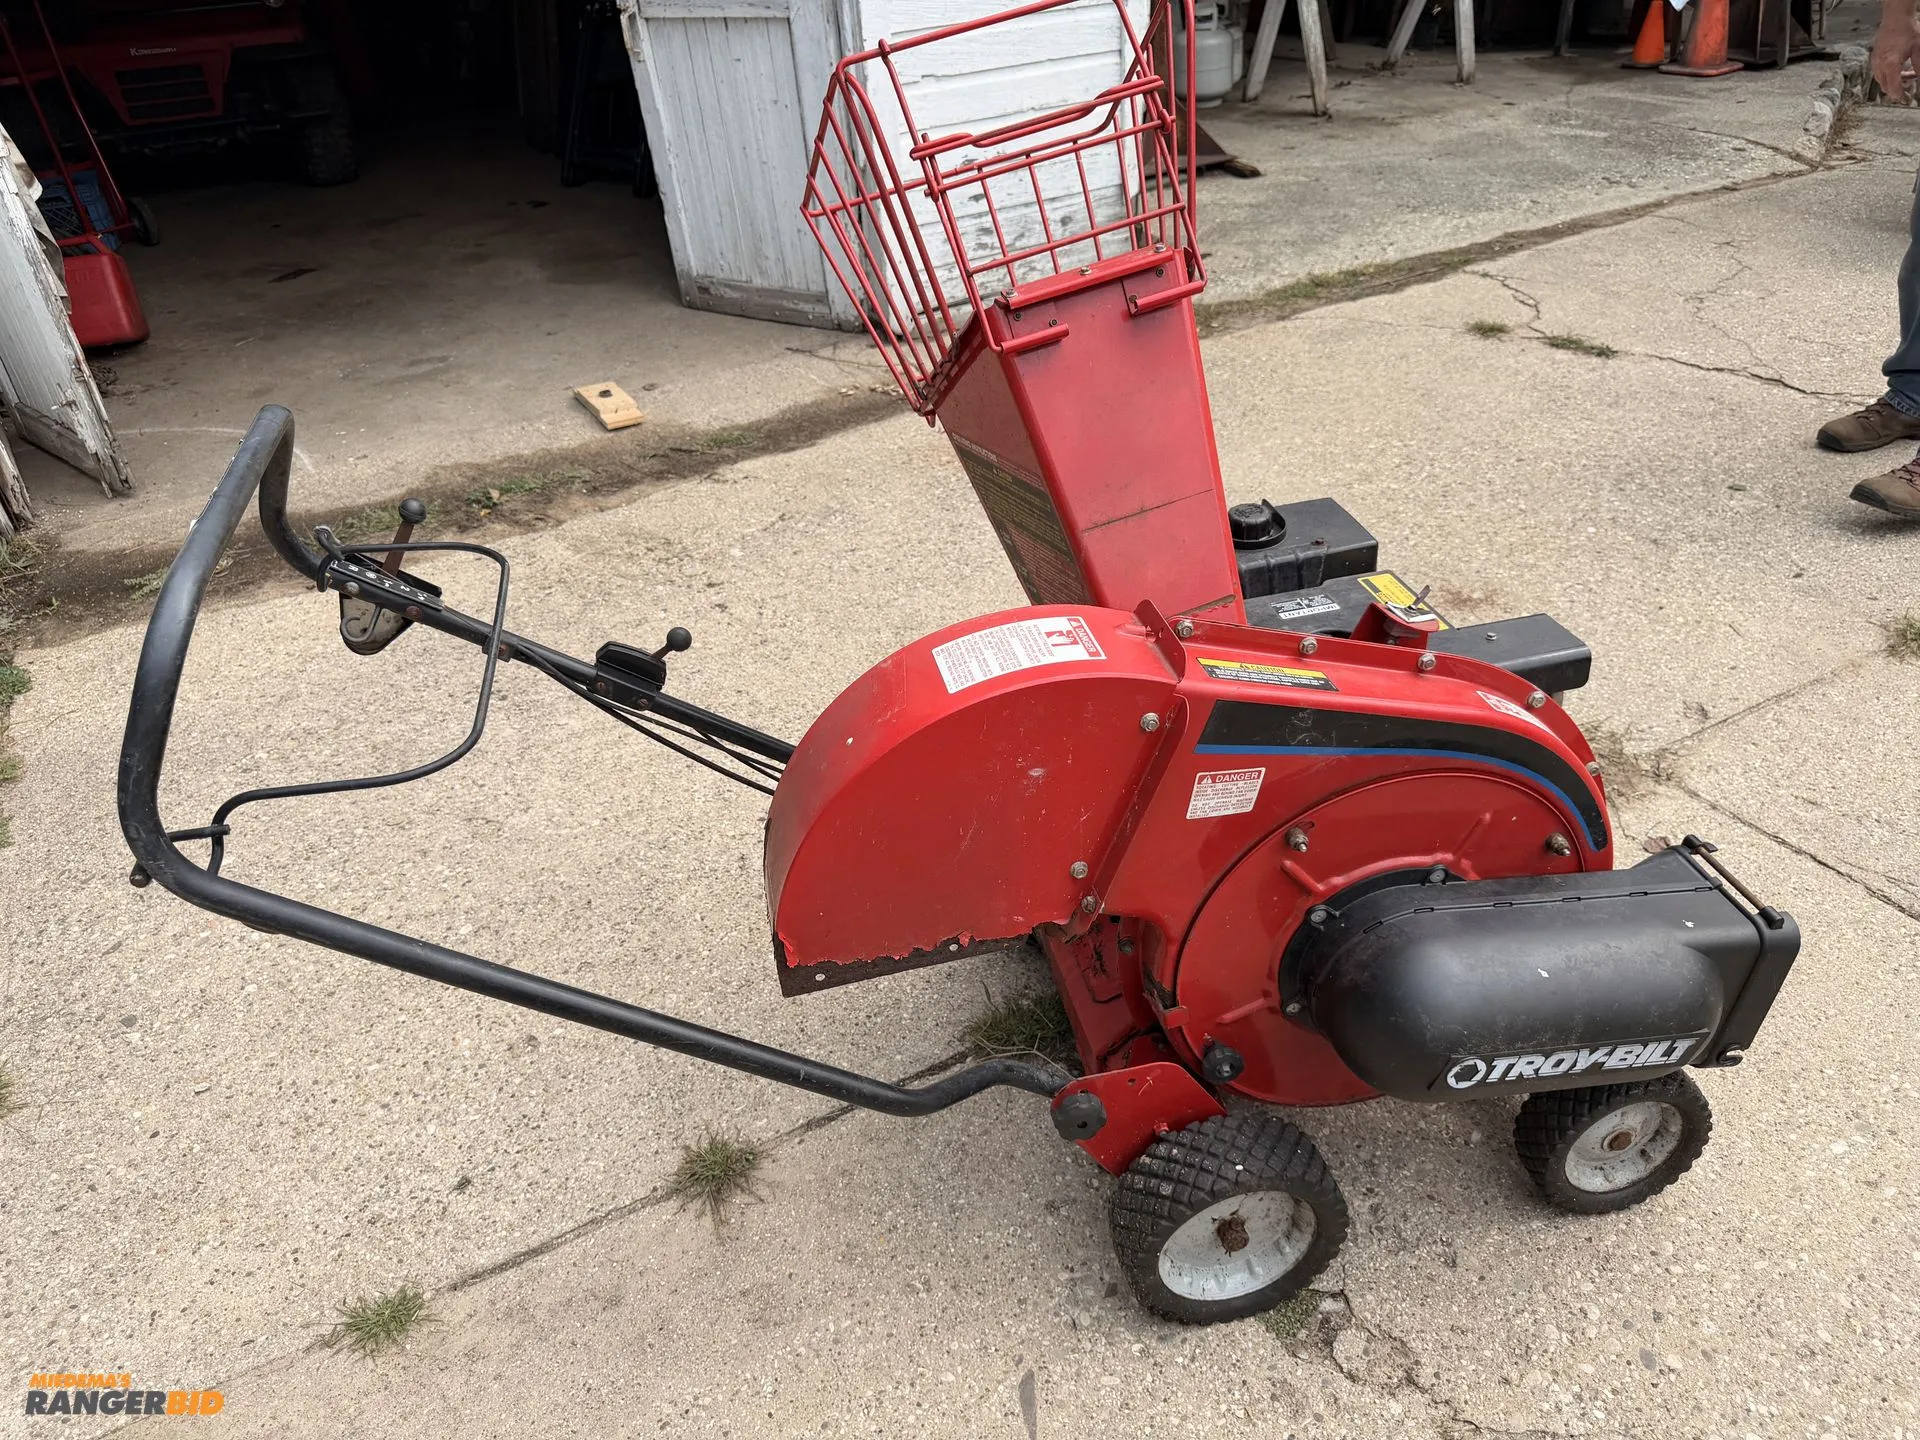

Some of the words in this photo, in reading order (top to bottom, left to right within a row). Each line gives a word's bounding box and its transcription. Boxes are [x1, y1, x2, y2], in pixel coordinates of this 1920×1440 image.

[1076, 627, 1097, 654] DANGER
[1216, 772, 1258, 783] DANGER
[1486, 1038, 1700, 1082] TROY-BILT
